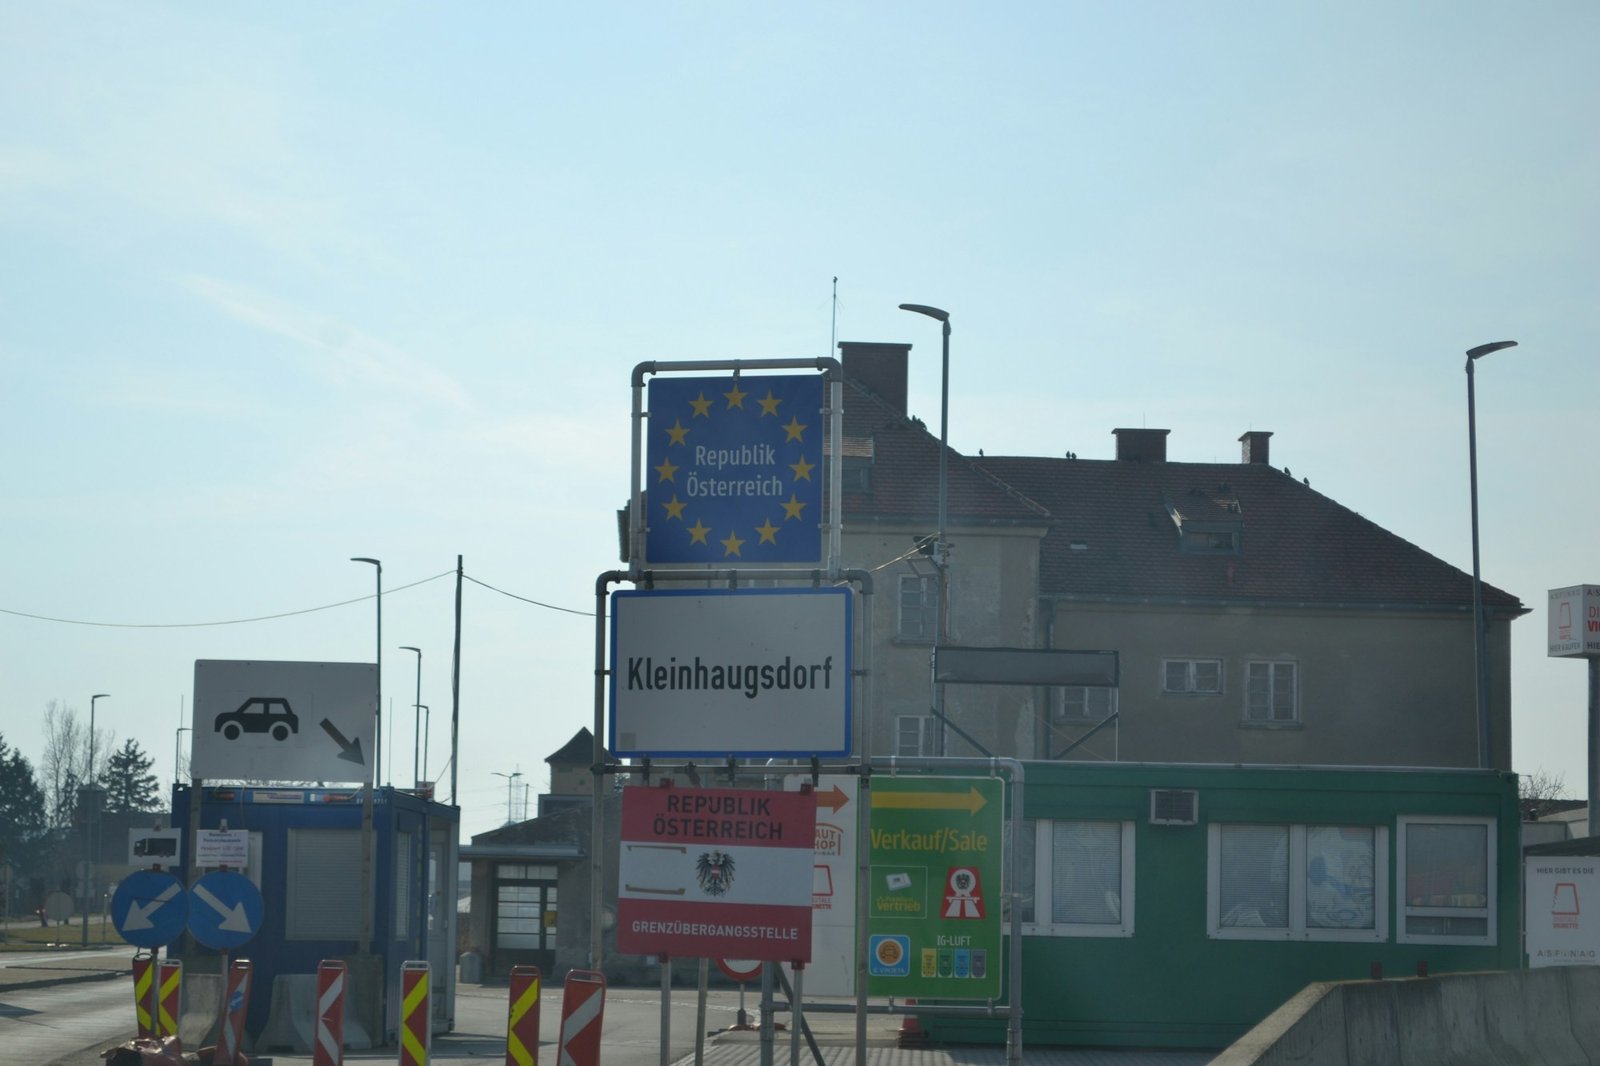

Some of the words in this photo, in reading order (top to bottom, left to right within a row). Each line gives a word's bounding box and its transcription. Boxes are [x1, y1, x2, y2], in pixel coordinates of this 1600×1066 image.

[695, 444, 776, 471] Republik
[686, 471, 783, 497] Österreich
[627, 656, 833, 700] Kleinhaugsdorf
[667, 794, 771, 816] REPUBLIK
[653, 813, 783, 840] ÖSTERREICH
[870, 827, 988, 853] Verkauf/Sale
[632, 920, 798, 940] GRENZÜBERGANGSSTELLE
[937, 936, 971, 947] IG-LUFT
